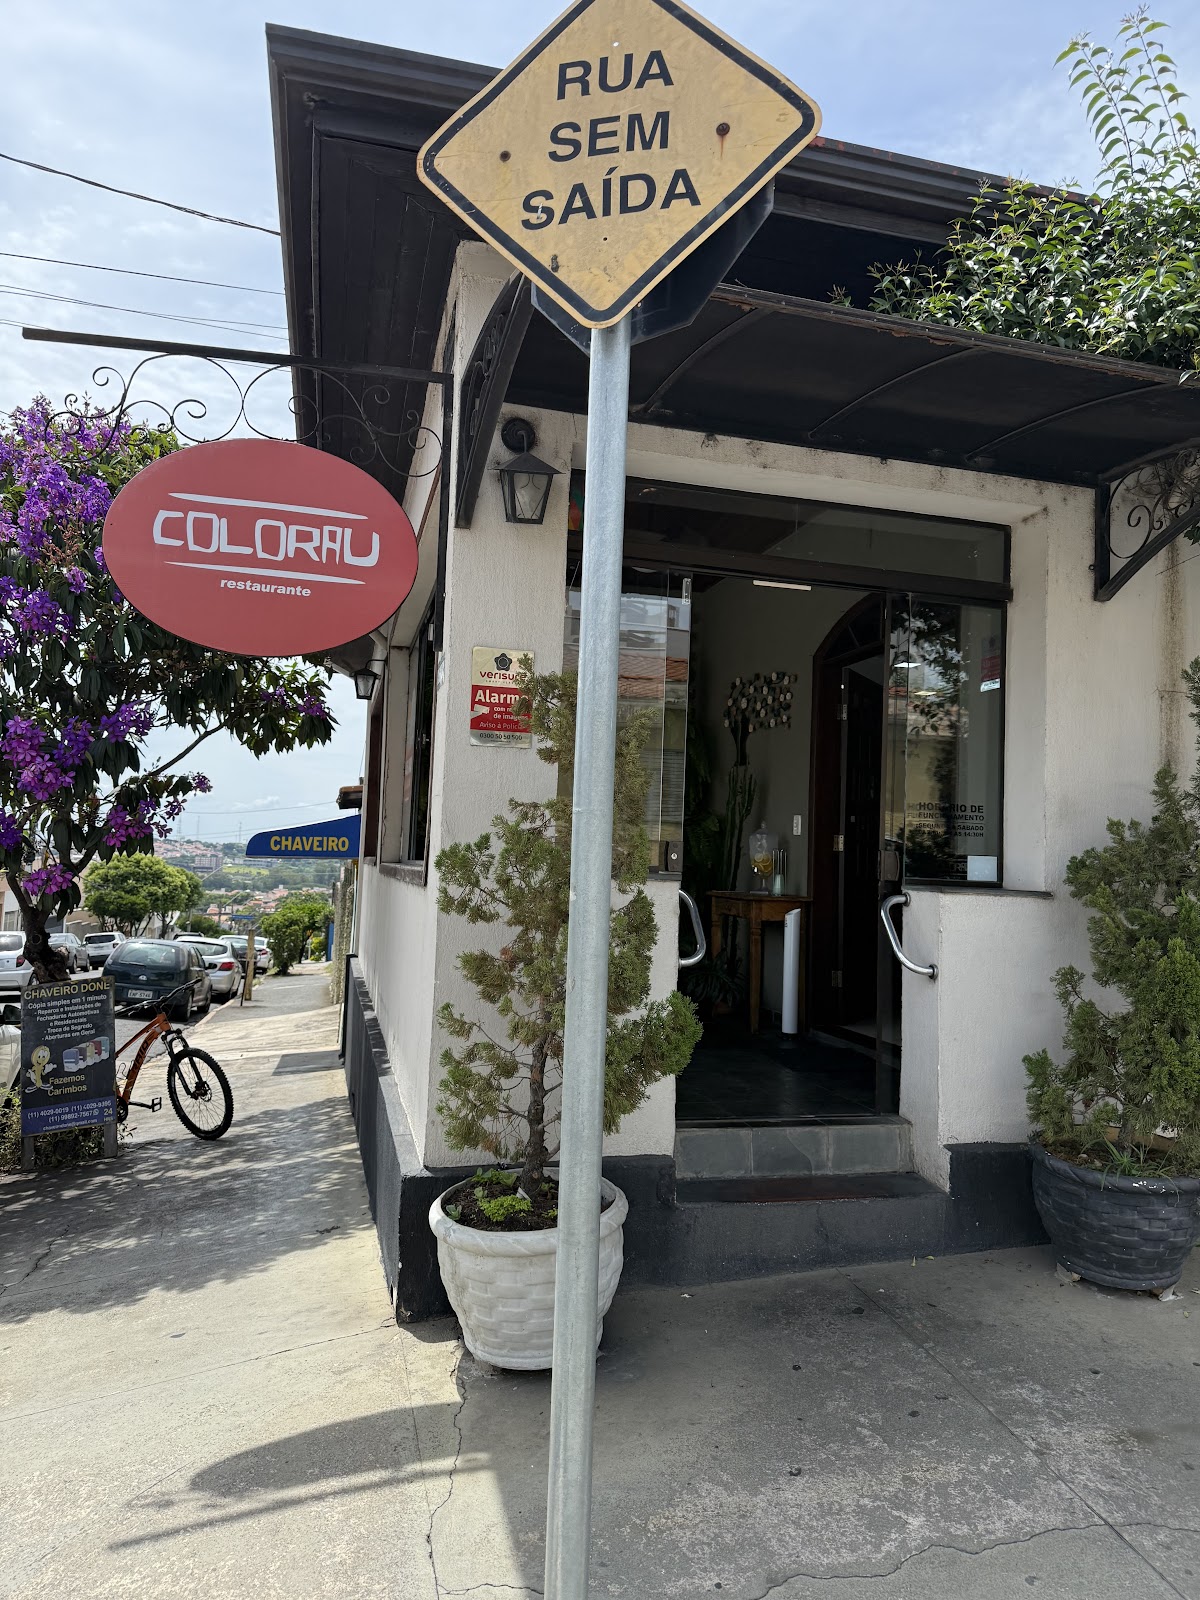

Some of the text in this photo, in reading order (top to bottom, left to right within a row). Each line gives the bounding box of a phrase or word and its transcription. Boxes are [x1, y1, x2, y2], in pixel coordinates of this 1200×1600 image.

[556, 49, 675, 101] RUA
[547, 110, 671, 163] SEM
[520, 166, 702, 231] SAÍDA
[152, 509, 380, 567] COLORAU
[220, 577, 312, 597] restaurante
[474, 689, 529, 705] Alarm
[479, 721, 496, 729] Aviso
[918, 801, 985, 814] HORRIO DE
[918, 811, 985, 821] FUNCAMENTO
[270, 835, 350, 852] CHAVEIRO
[24, 981, 110, 1000] CHAVEIRO DONE
[27, 1001, 46, 1010] Cópia
[46, 998, 71, 1008] simples
[86, 993, 107, 1002] minuto
[36, 1009, 100, 1022] Fechaduras Automotivas
[37, 1007, 60, 1016] Reparos
[47, 1026, 62, 1034] Troca
[70, 1023, 93, 1033] Segredo
[53, 1017, 88, 1026] Residenciais
[44, 1032, 71, 1041] Aberturas
[49, 1074, 86, 1085] Fazemos
[47, 1084, 88, 1097] Carimbos
[27, 1111, 40, 1119] (11)
[71, 1105, 83, 1113] (11)
[48, 1115, 60, 1123] (11)
[103, 1108, 113, 1116] 24
